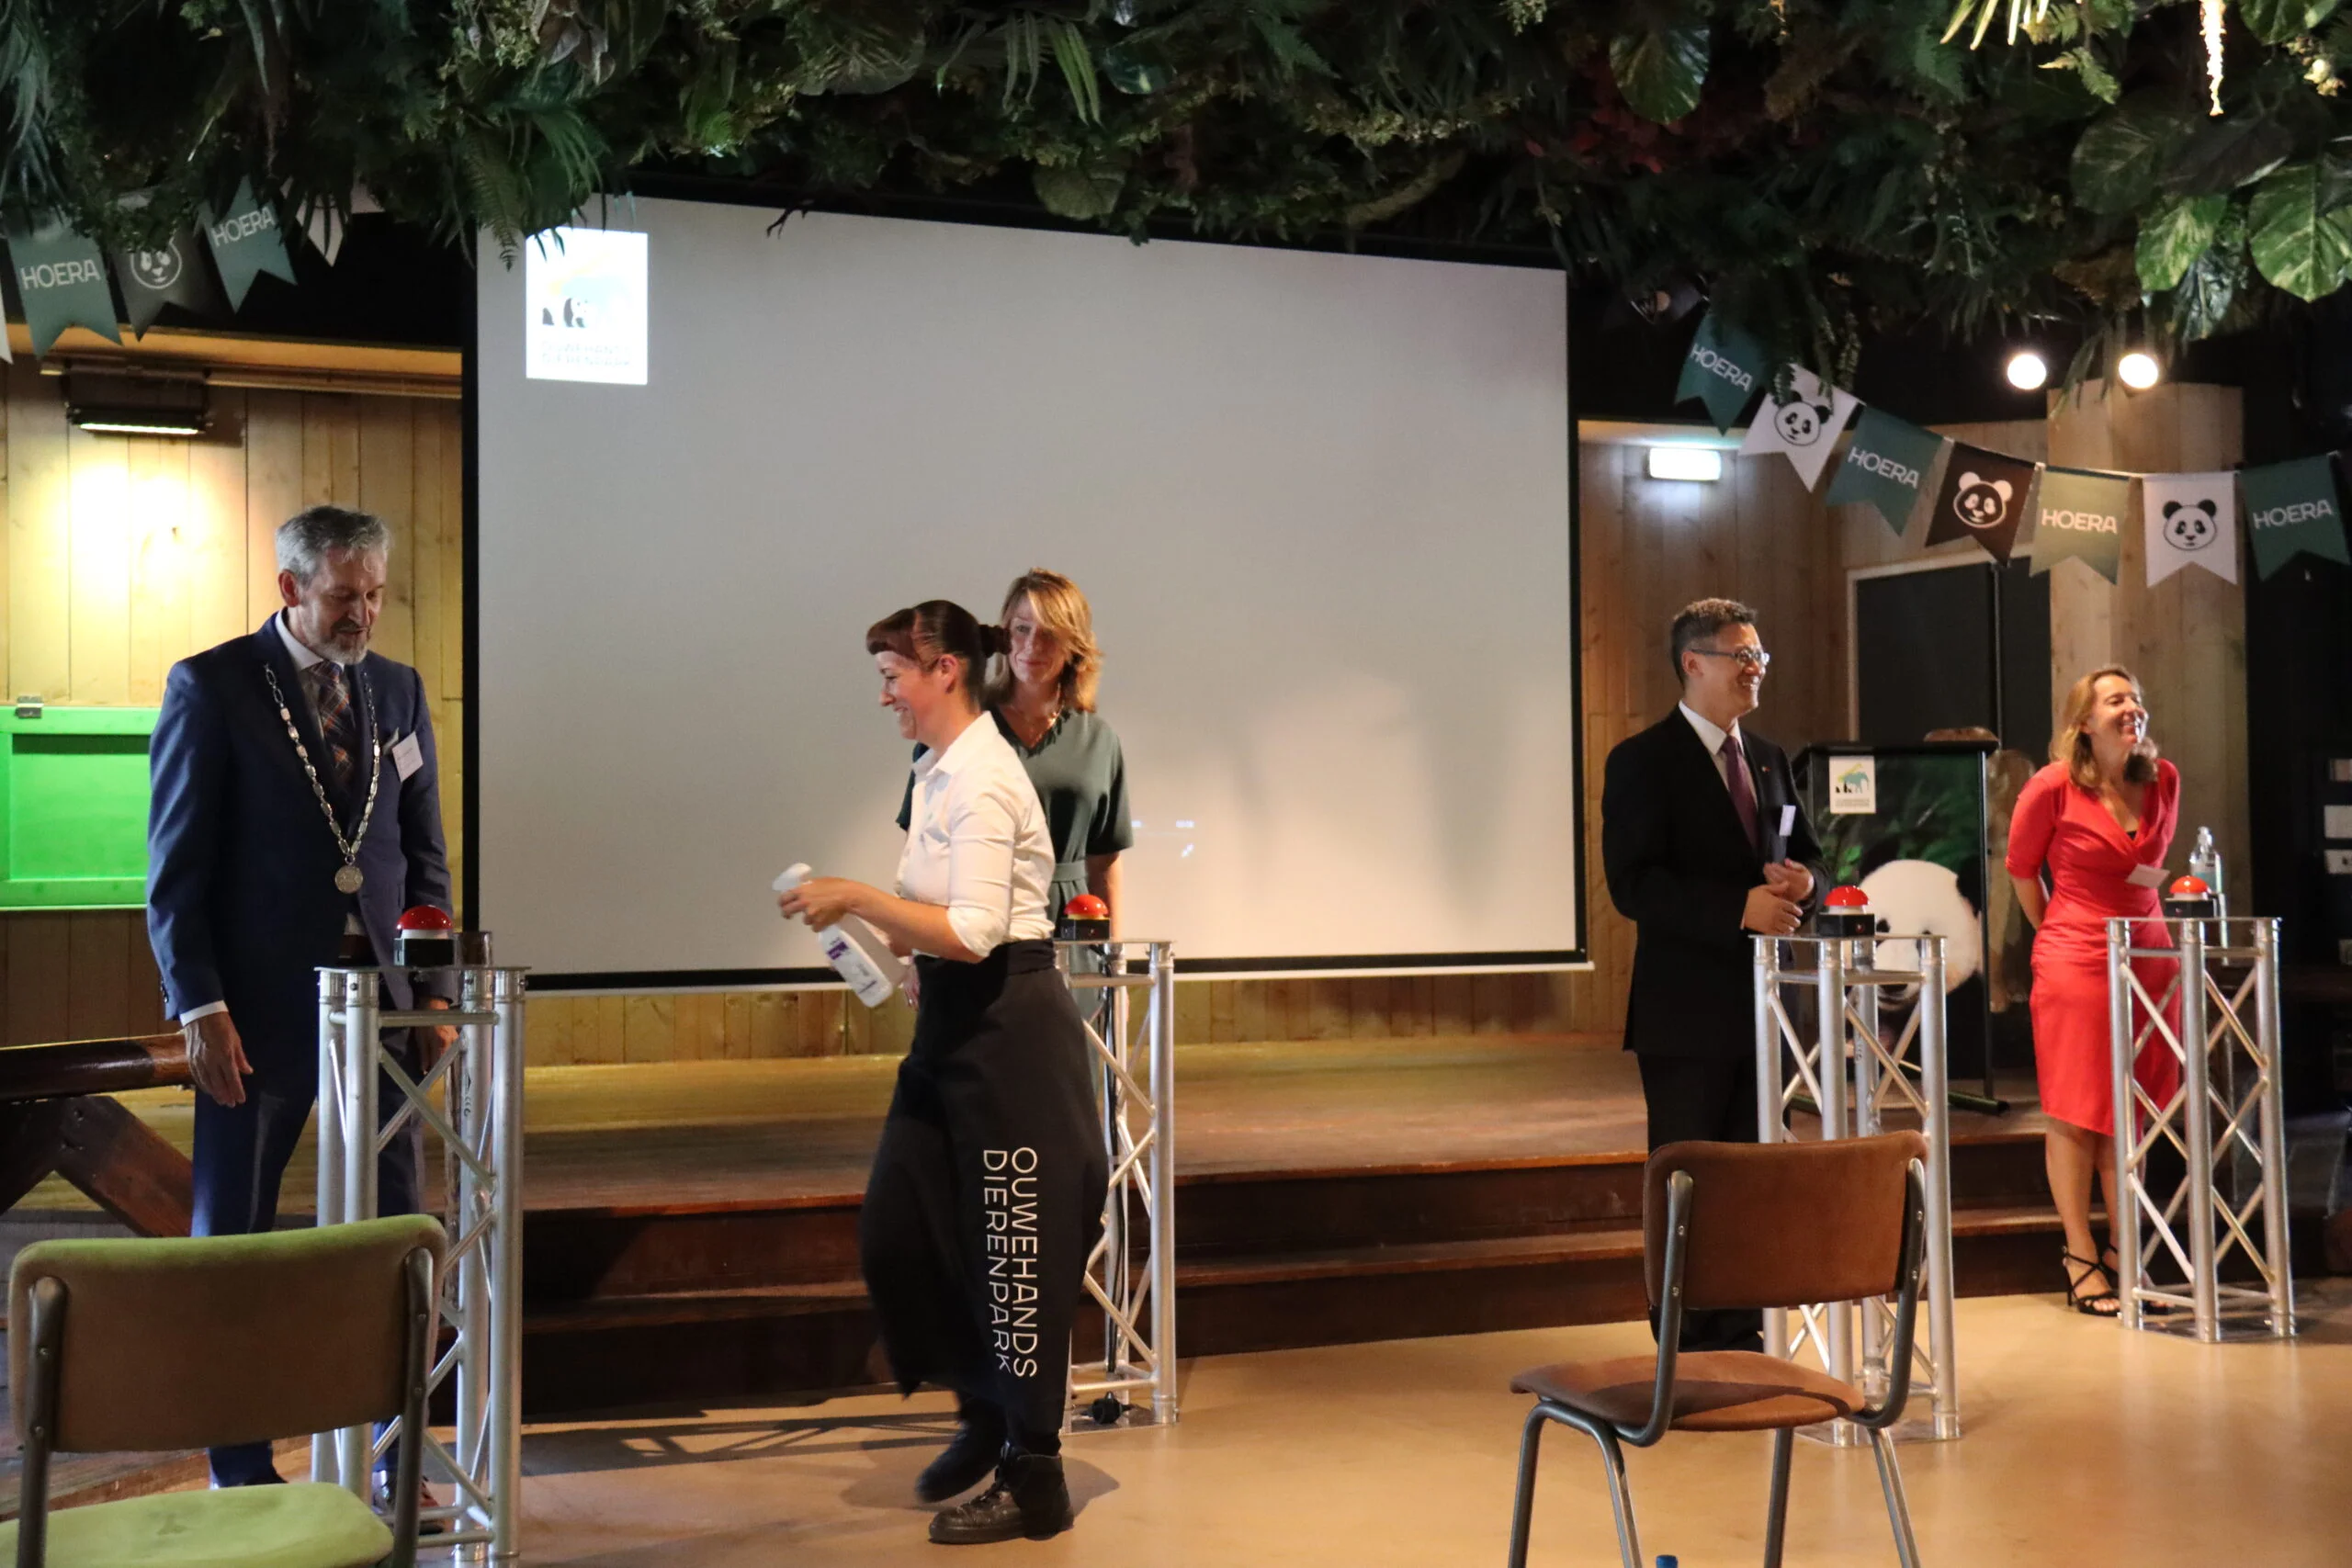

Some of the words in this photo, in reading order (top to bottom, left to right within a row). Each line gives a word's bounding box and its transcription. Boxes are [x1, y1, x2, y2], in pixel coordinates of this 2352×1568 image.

[210, 206, 275, 247] HOERA
[19, 259, 100, 289] HOERA
[1689, 344, 1753, 392] HOERA
[1847, 446, 1920, 490] HOERA
[2041, 508, 2119, 535] HOERA
[2253, 499, 2333, 530] HOERA
[983, 1149, 1012, 1374] DIERENPARK
[1012, 1146, 1038, 1378] OUWEHANDS
